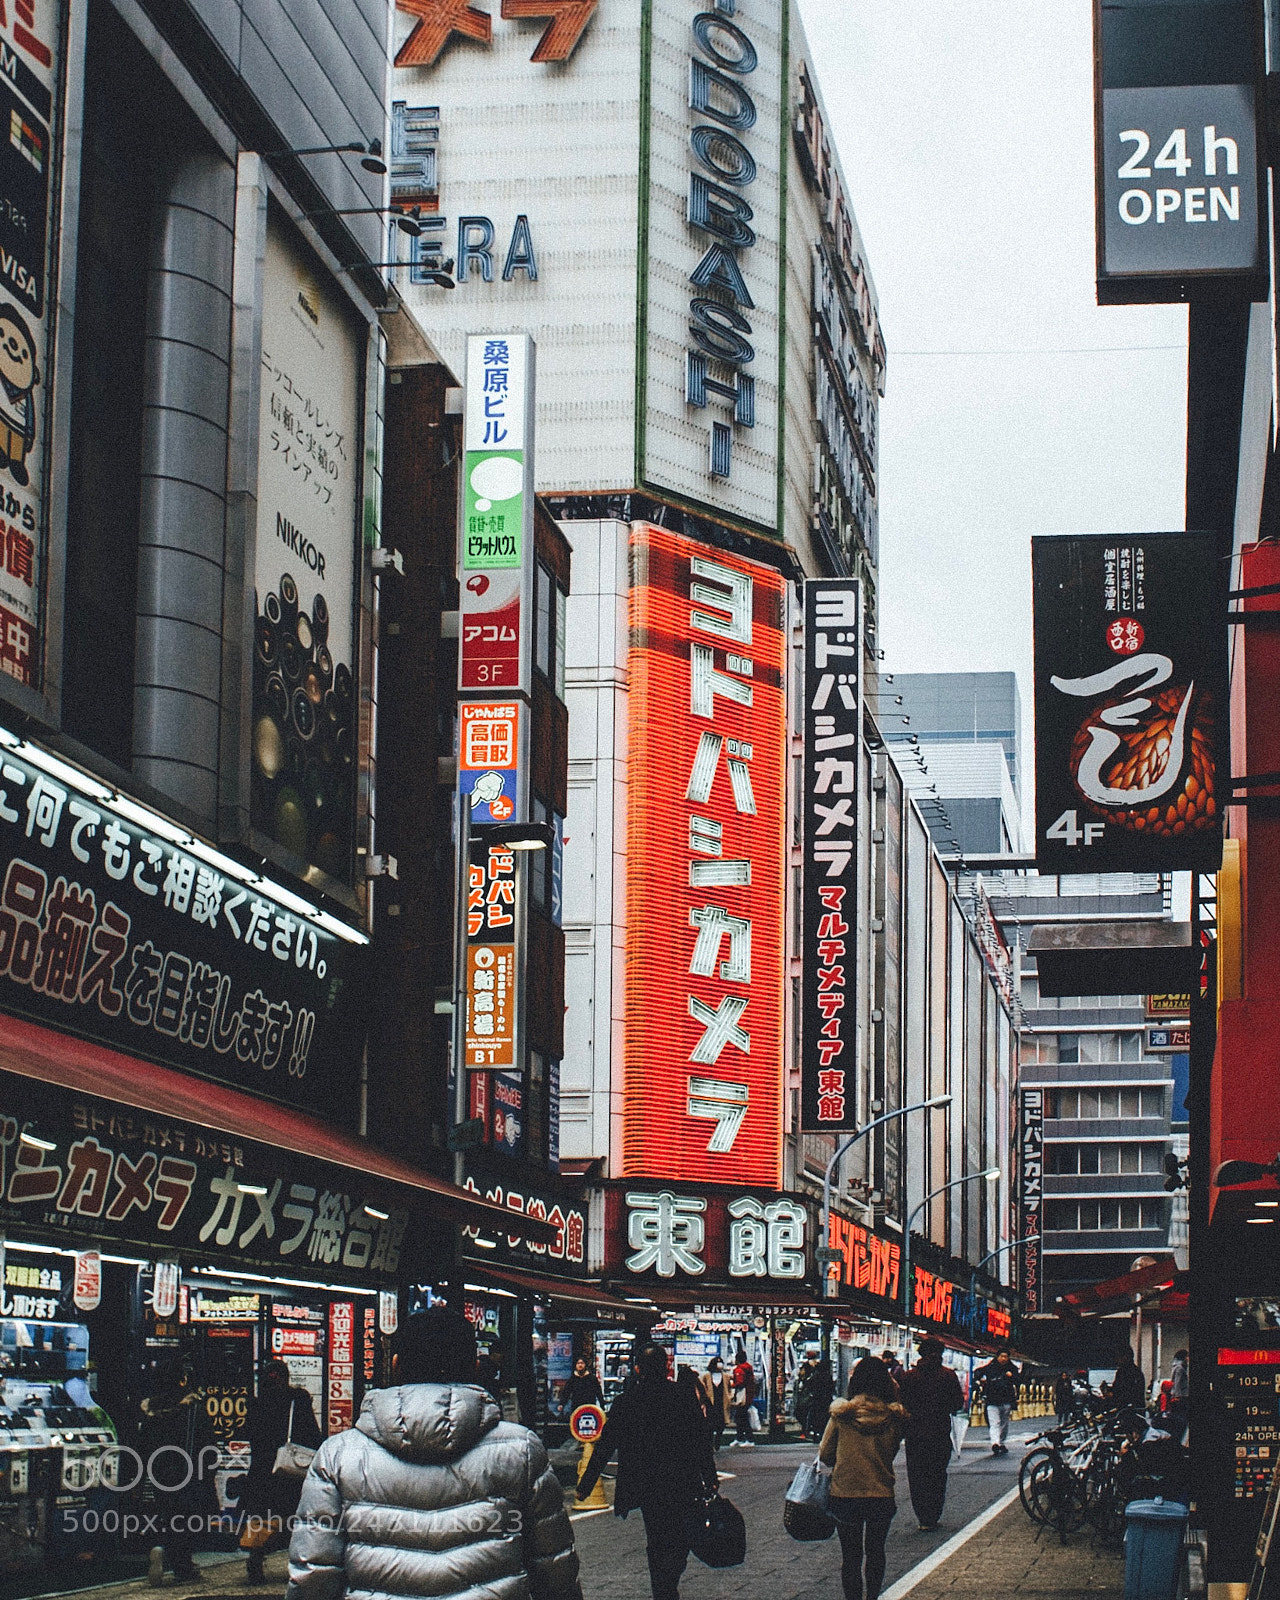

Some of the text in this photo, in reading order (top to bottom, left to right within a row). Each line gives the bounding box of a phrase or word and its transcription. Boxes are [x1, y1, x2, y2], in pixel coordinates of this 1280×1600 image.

[1118, 186, 1240, 225] OPEN
[685, 0, 758, 478] ODOBASHI
[0, 246, 37, 302] VISA
[483, 339, 510, 445] 桑原ビル
[276, 511, 326, 580] NIKKOR
[1104, 548, 1117, 611] 個室居酒屋
[1120, 548, 1131, 611] 焼酎を楽しむ
[464, 625, 517, 642] アコム
[1110, 621, 1124, 651] 西口
[1125, 621, 1139, 651] 新宿
[476, 664, 503, 683] 3F
[463, 707, 516, 719] じゃんぱら
[470, 724, 509, 742] 高価
[811, 590, 857, 878] ヨドバシカメラ
[470, 744, 509, 763] 買取
[492, 801, 511, 816] 2F
[1045, 809, 1105, 846] 4F
[686, 555, 757, 1154] ヨドバシカメラ
[486, 847, 515, 929] ドバシ
[816, 885, 848, 1122] マルチメディア東館
[1153, 1005, 1190, 1015] YAMAZAK
[474, 1050, 495, 1063] B1
[1152, 1031, 1167, 1047] 酒
[1024, 1091, 1043, 1213] ヨドバシカメラ
[199, 1165, 408, 1273] カメラ総合館
[625, 1189, 808, 1280] 東館
[332, 1302, 351, 1364] 欢迎光临
[1239, 1377, 1259, 1387] 103
[1246, 1406, 1259, 1416] 19
[1235, 1432, 1280, 1442] 24h OPE
